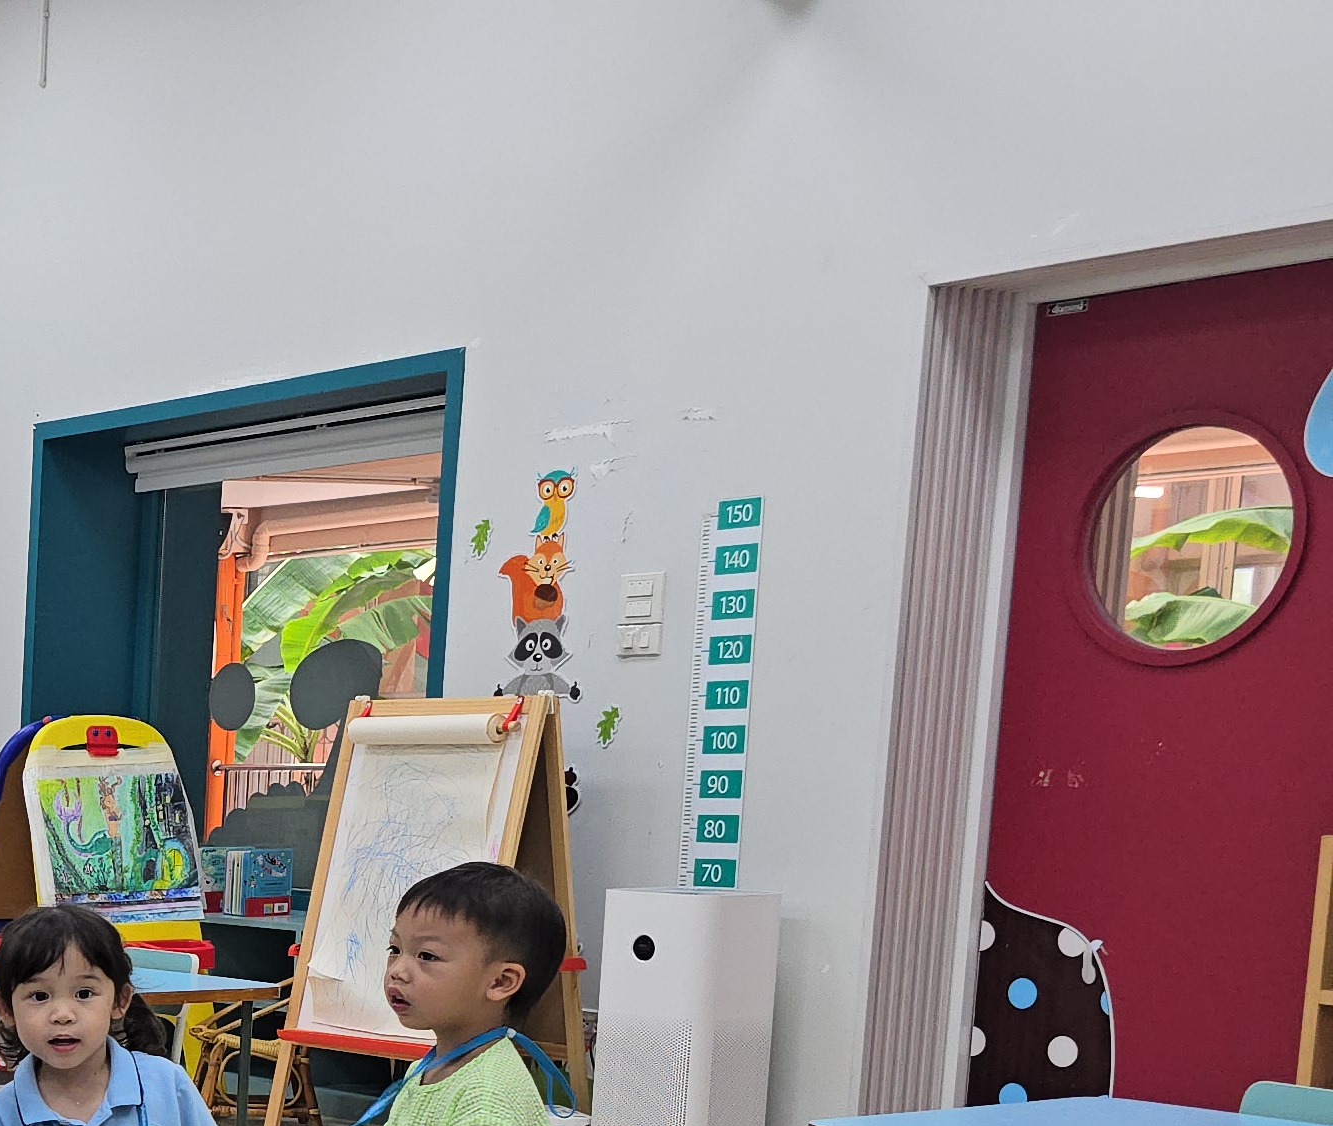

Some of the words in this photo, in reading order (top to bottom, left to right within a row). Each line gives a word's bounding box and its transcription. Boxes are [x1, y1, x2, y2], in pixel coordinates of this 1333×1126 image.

[726, 504, 753, 523] 150
[723, 550, 749, 568] 140
[720, 596, 746, 614] 130
[717, 641, 743, 659] 120
[715, 687, 740, 705] 110
[711, 732, 737, 750] 100
[707, 776, 728, 794] 90
[704, 821, 725, 838] 80
[701, 864, 722, 882] 70
